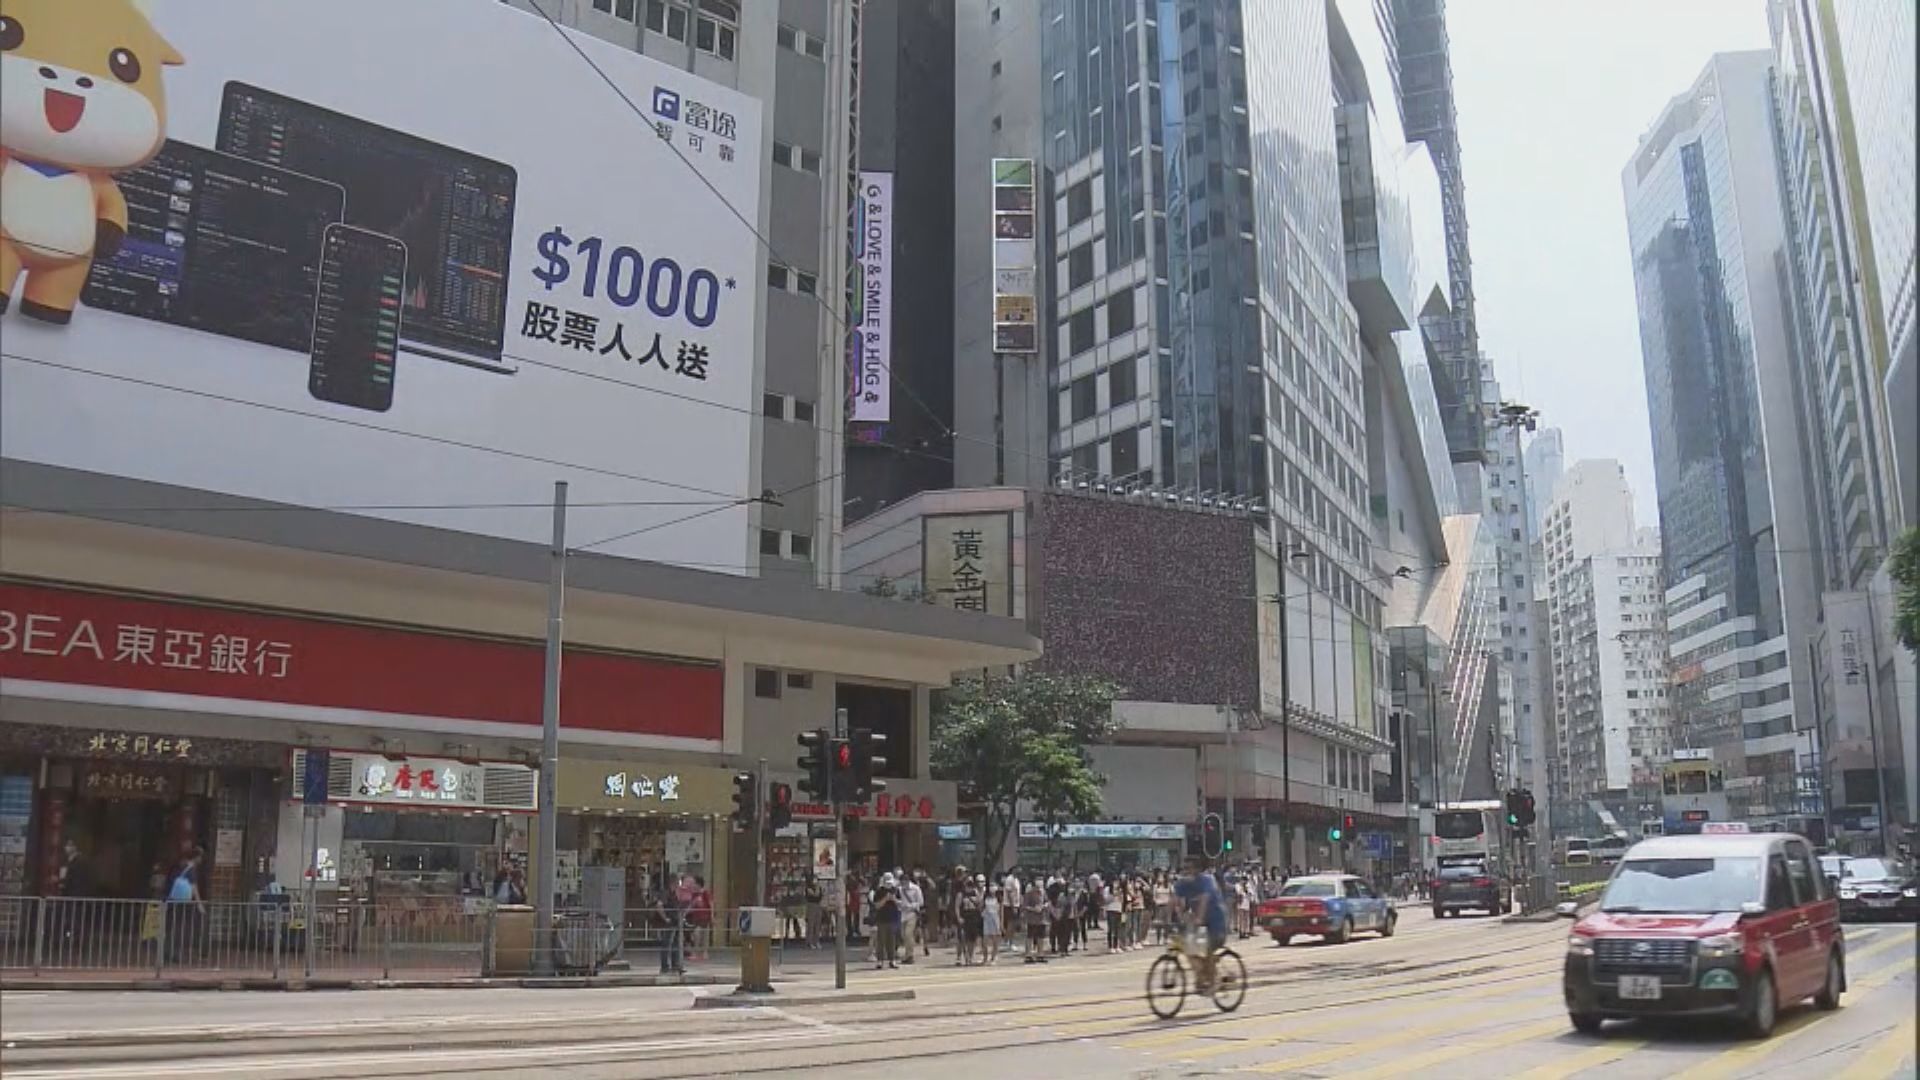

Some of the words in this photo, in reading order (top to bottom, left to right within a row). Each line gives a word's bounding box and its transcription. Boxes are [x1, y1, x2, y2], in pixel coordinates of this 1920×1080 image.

[685, 100, 736, 141] 富途
[867, 219, 882, 259] LOVE
[867, 279, 882, 327] SMILE
[521, 300, 709, 381] 股票人人送
[865, 347, 880, 385] HUG
[113, 624, 293, 678] 東亞銀行
